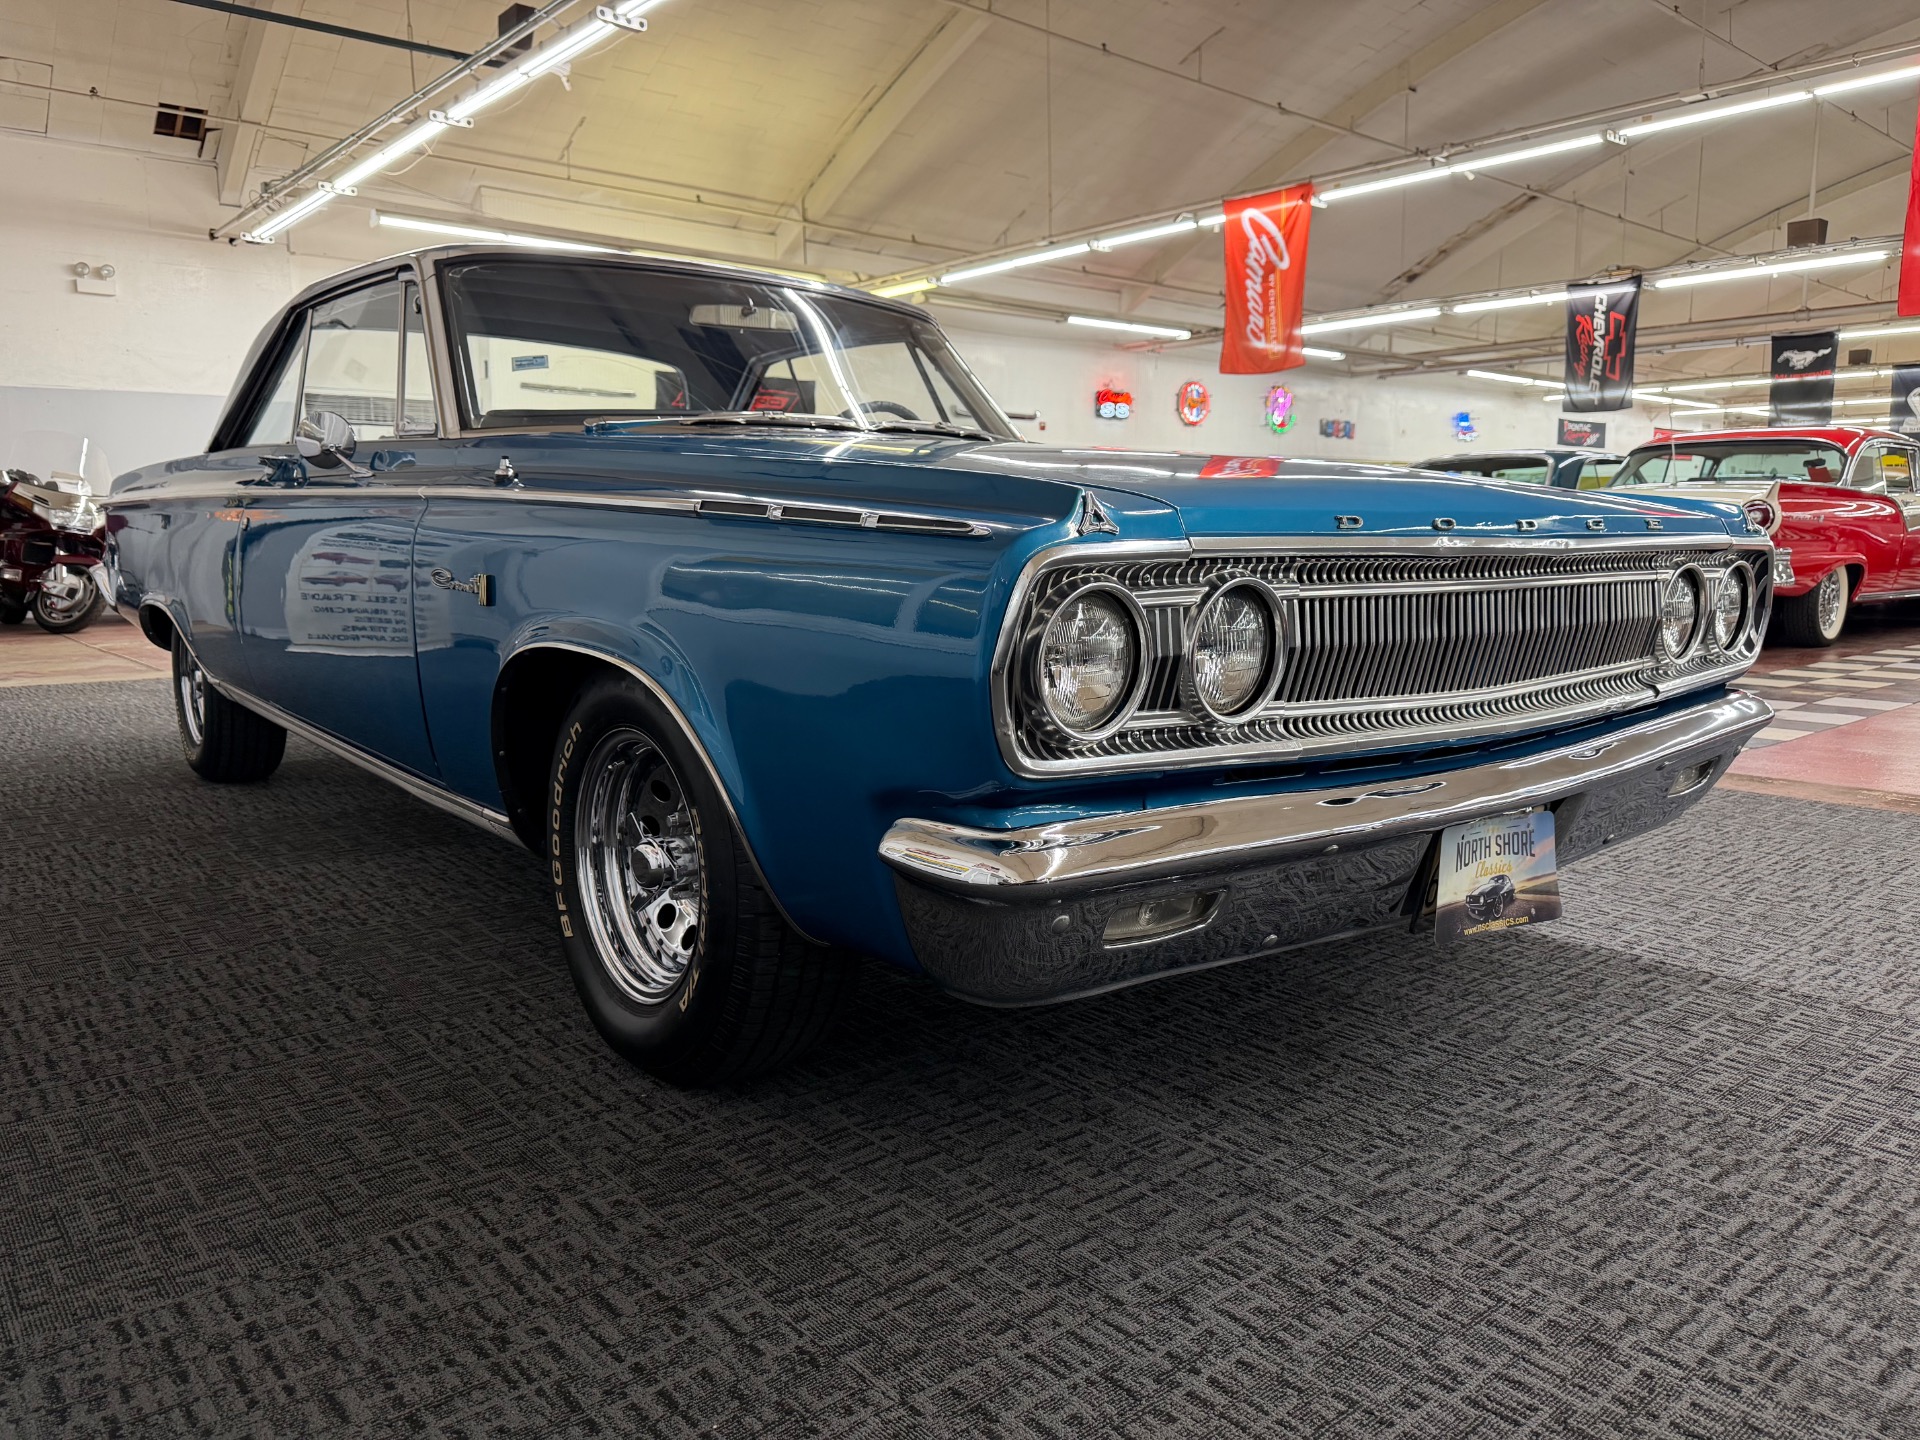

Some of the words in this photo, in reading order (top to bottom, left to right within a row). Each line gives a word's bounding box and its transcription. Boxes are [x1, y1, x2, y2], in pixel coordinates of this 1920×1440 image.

[1241, 208, 1290, 348] Camaro
[1574, 314, 1594, 378] Racing
[1589, 292, 1608, 405] CHEVROLET
[1099, 402, 1130, 418] SS
[1334, 514, 1664, 531] DODGE
[1455, 835, 1491, 872] NORTH
[1495, 829, 1536, 857] SHORE
[1475, 859, 1514, 879] Classics
[1463, 915, 1529, 936] www.nsclassics.com
